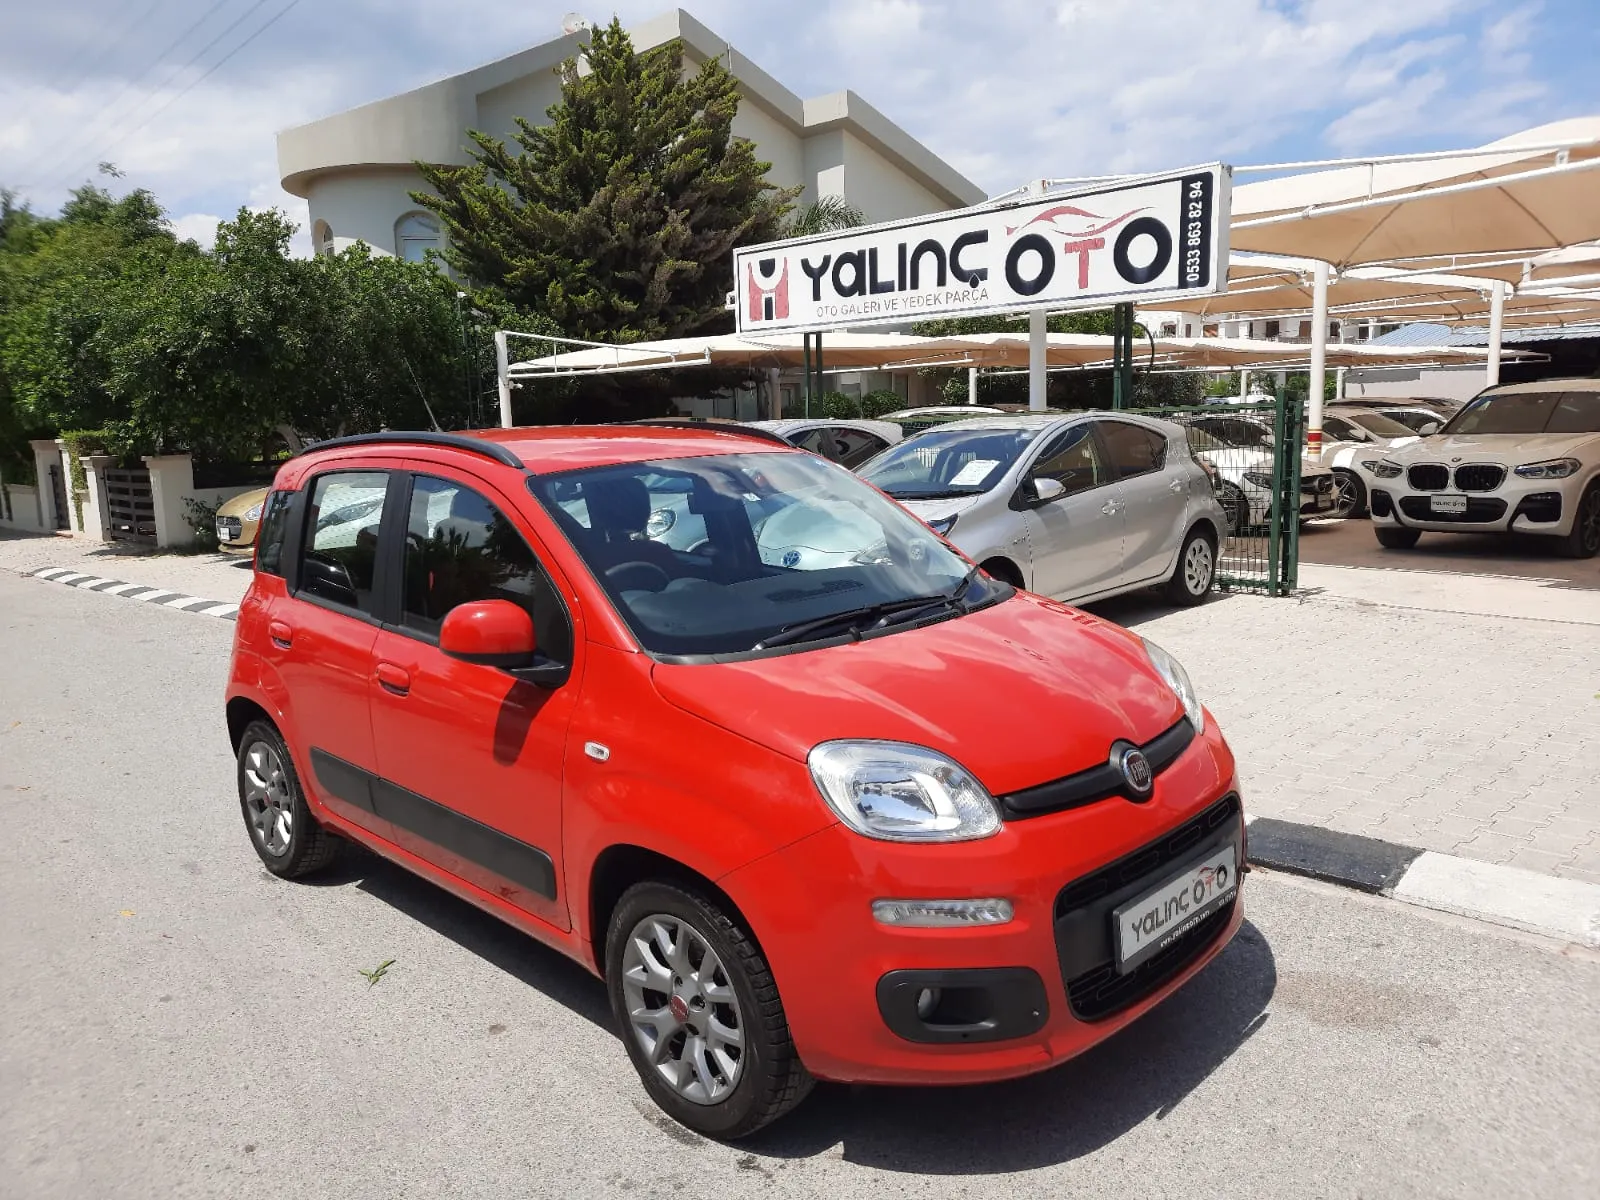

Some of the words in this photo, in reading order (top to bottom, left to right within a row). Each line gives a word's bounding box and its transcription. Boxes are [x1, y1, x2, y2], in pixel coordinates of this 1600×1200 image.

[1189, 181, 1203, 199] 94
[1189, 201, 1202, 218] 82
[1188, 221, 1201, 246] 863
[1005, 216, 1172, 296] OTO
[1186, 249, 1200, 281] 0533
[817, 305, 838, 317] OTO
[884, 297, 898, 311] VE
[902, 293, 942, 308] YEDEK
[945, 288, 989, 304] PARÇA
[1193, 864, 1228, 904] OTO
